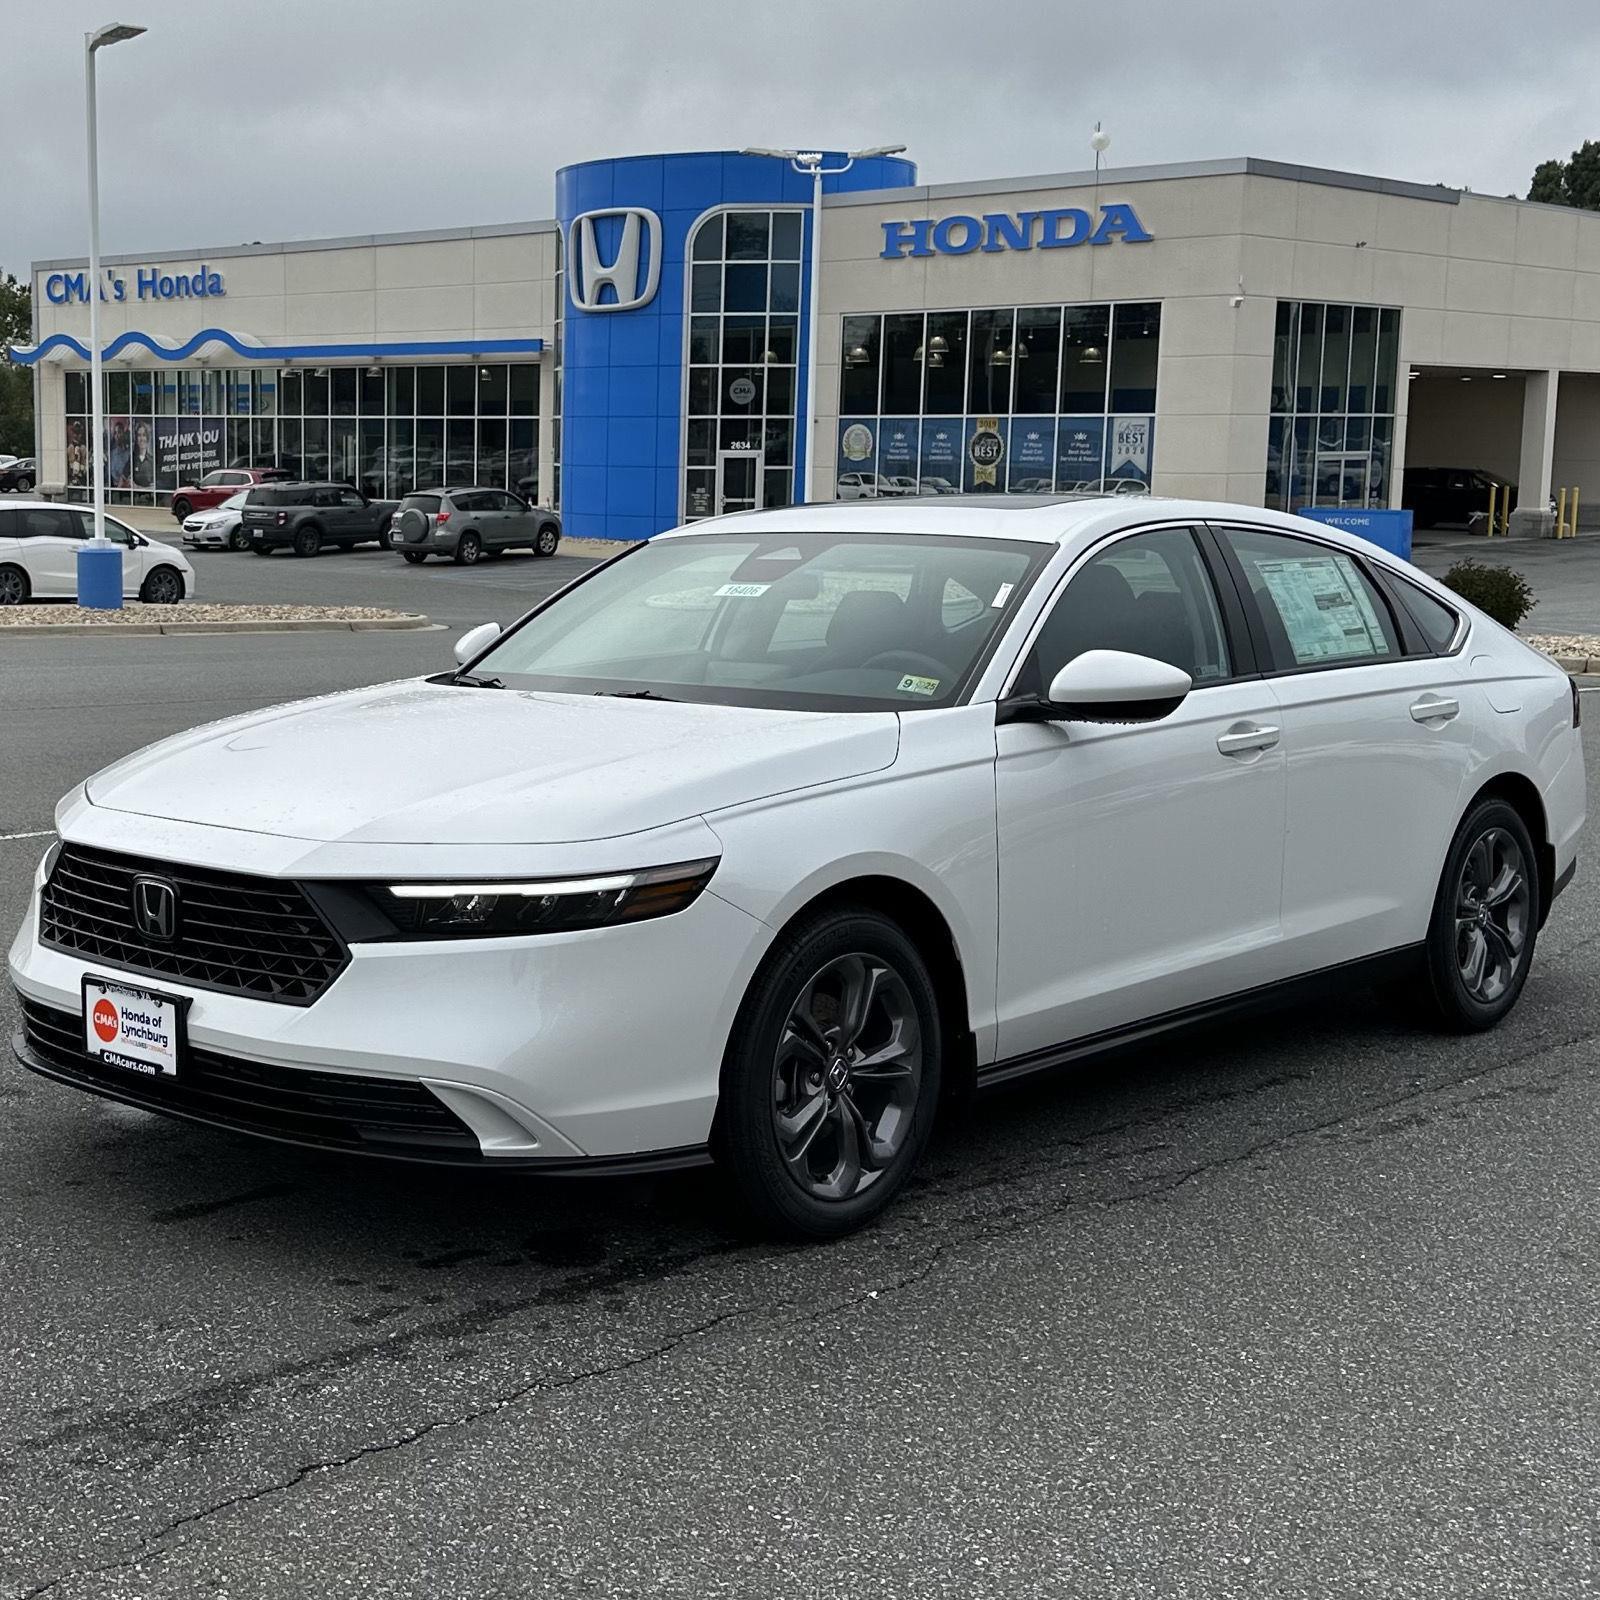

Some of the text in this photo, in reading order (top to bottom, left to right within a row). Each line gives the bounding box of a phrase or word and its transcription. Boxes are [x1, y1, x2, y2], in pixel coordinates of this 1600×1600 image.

[880, 203, 1154, 259] HONDA
[137, 264, 226, 300] Honda
[158, 429, 219, 449] THANK YOU
[730, 441, 751, 450] 2634
[1118, 432, 1145, 444] BEST
[974, 447, 997, 457] BEST
[1325, 517, 1370, 526] WELCOME
[724, 585, 761, 595] 16406
[902, 679, 913, 688] 9
[94, 1012, 118, 1029] CMA's
[121, 1006, 162, 1028] Honda of
[121, 1021, 168, 1048] Lynchburg
[103, 1051, 156, 1076] CMAcars.com
